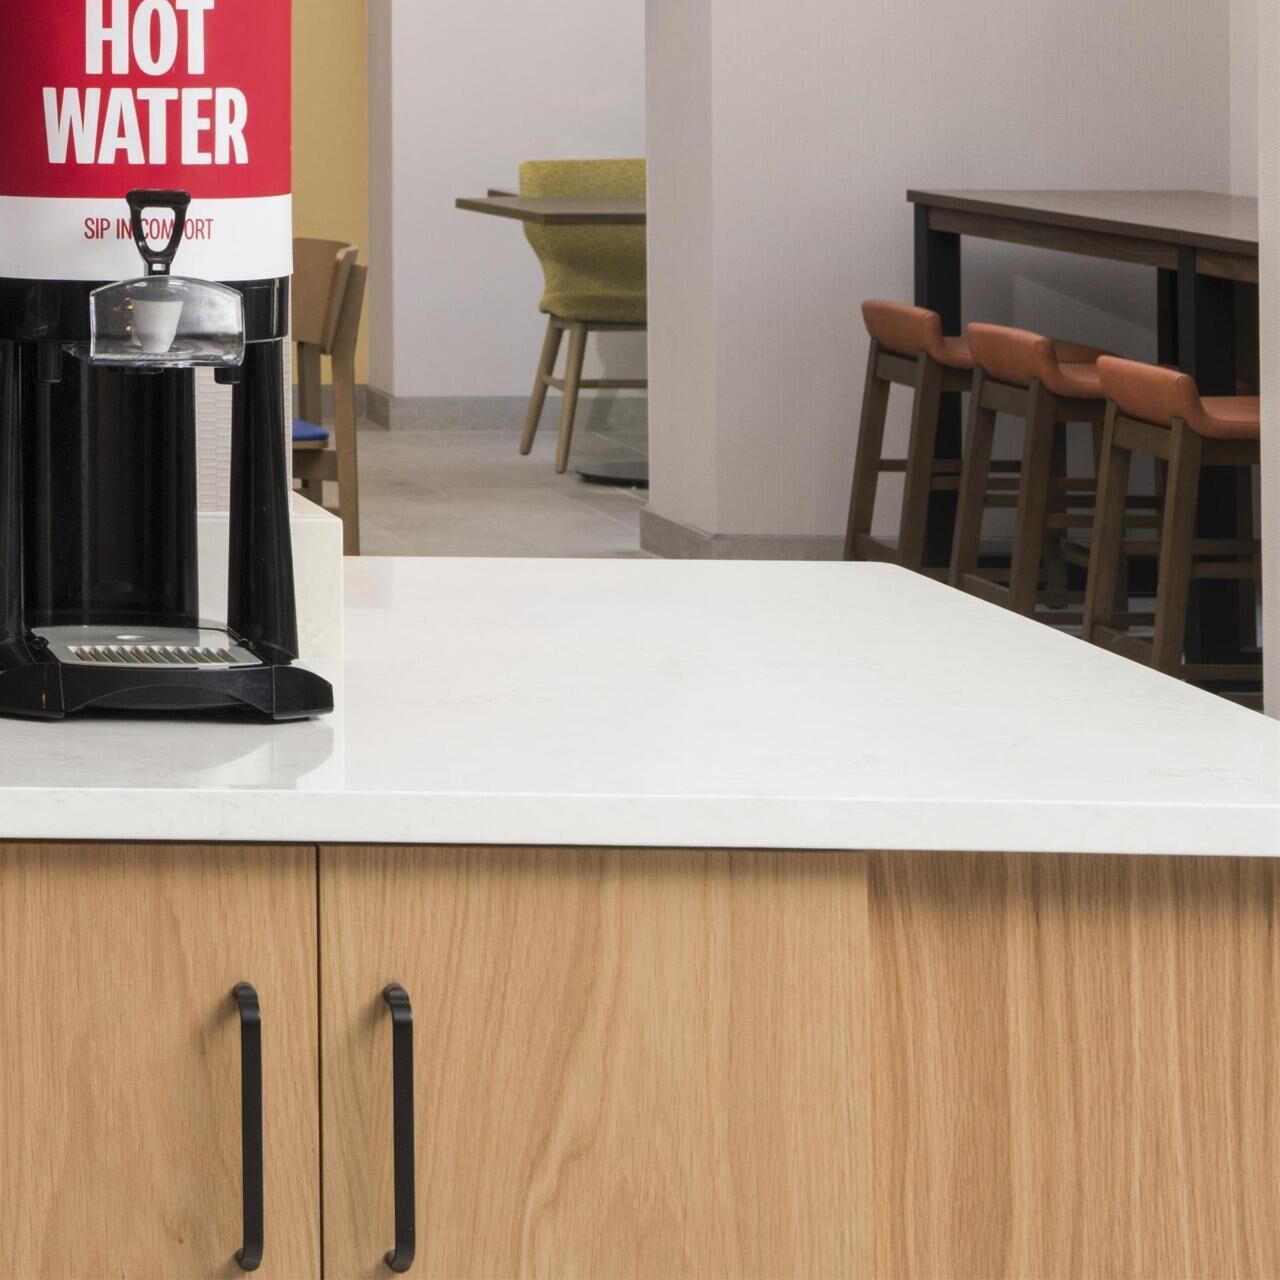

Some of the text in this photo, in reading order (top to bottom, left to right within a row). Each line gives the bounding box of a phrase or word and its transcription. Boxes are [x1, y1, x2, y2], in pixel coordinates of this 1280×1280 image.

[42, 86, 249, 166] WATER
[83, 217, 215, 240] SIP IN COMORT
